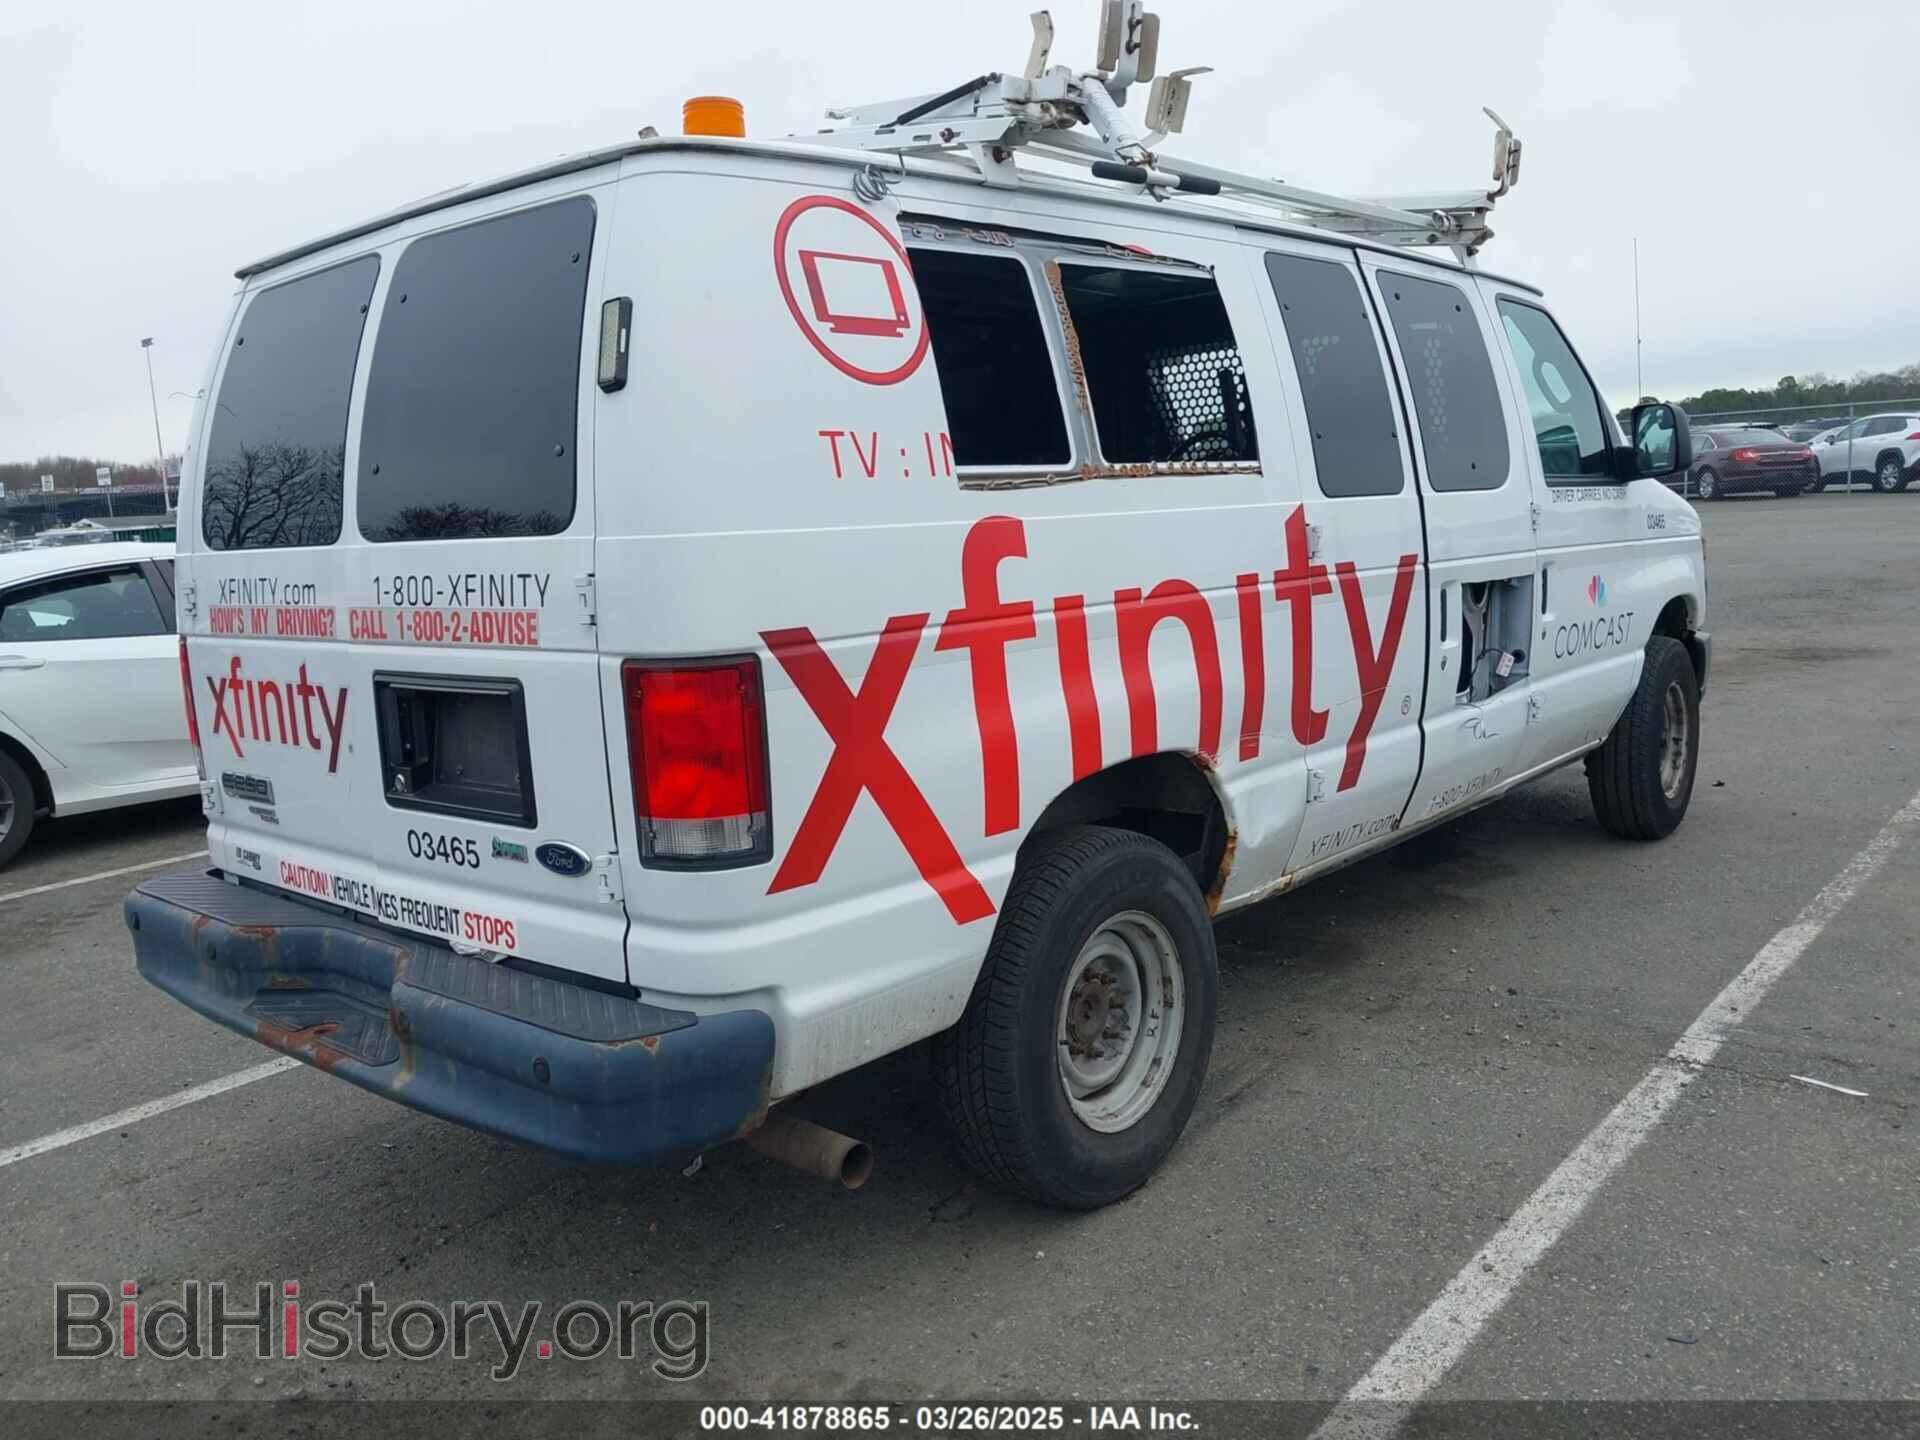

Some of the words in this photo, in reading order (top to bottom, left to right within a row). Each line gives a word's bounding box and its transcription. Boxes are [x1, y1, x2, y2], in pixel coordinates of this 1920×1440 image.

[818, 430, 878, 479] TV
[218, 578, 316, 605] XFINITY.com
[373, 574, 550, 607] 1-800-XFINITY
[209, 607, 245, 634] HOW'S
[250, 607, 269, 634] MY
[276, 608, 335, 637] DRIVING?
[350, 608, 388, 639] CALL
[396, 610, 539, 645] 1-800-2-ADVISE
[1554, 612, 1633, 659] COMCAST
[206, 656, 348, 773] xfinity
[758, 501, 1419, 926] xfinity
[407, 829, 480, 869] 03465
[280, 860, 330, 896] CAUTION!
[330, 875, 371, 909] VEHICLE
[400, 896, 460, 937] FREQUENT
[464, 911, 516, 950] STOPS
